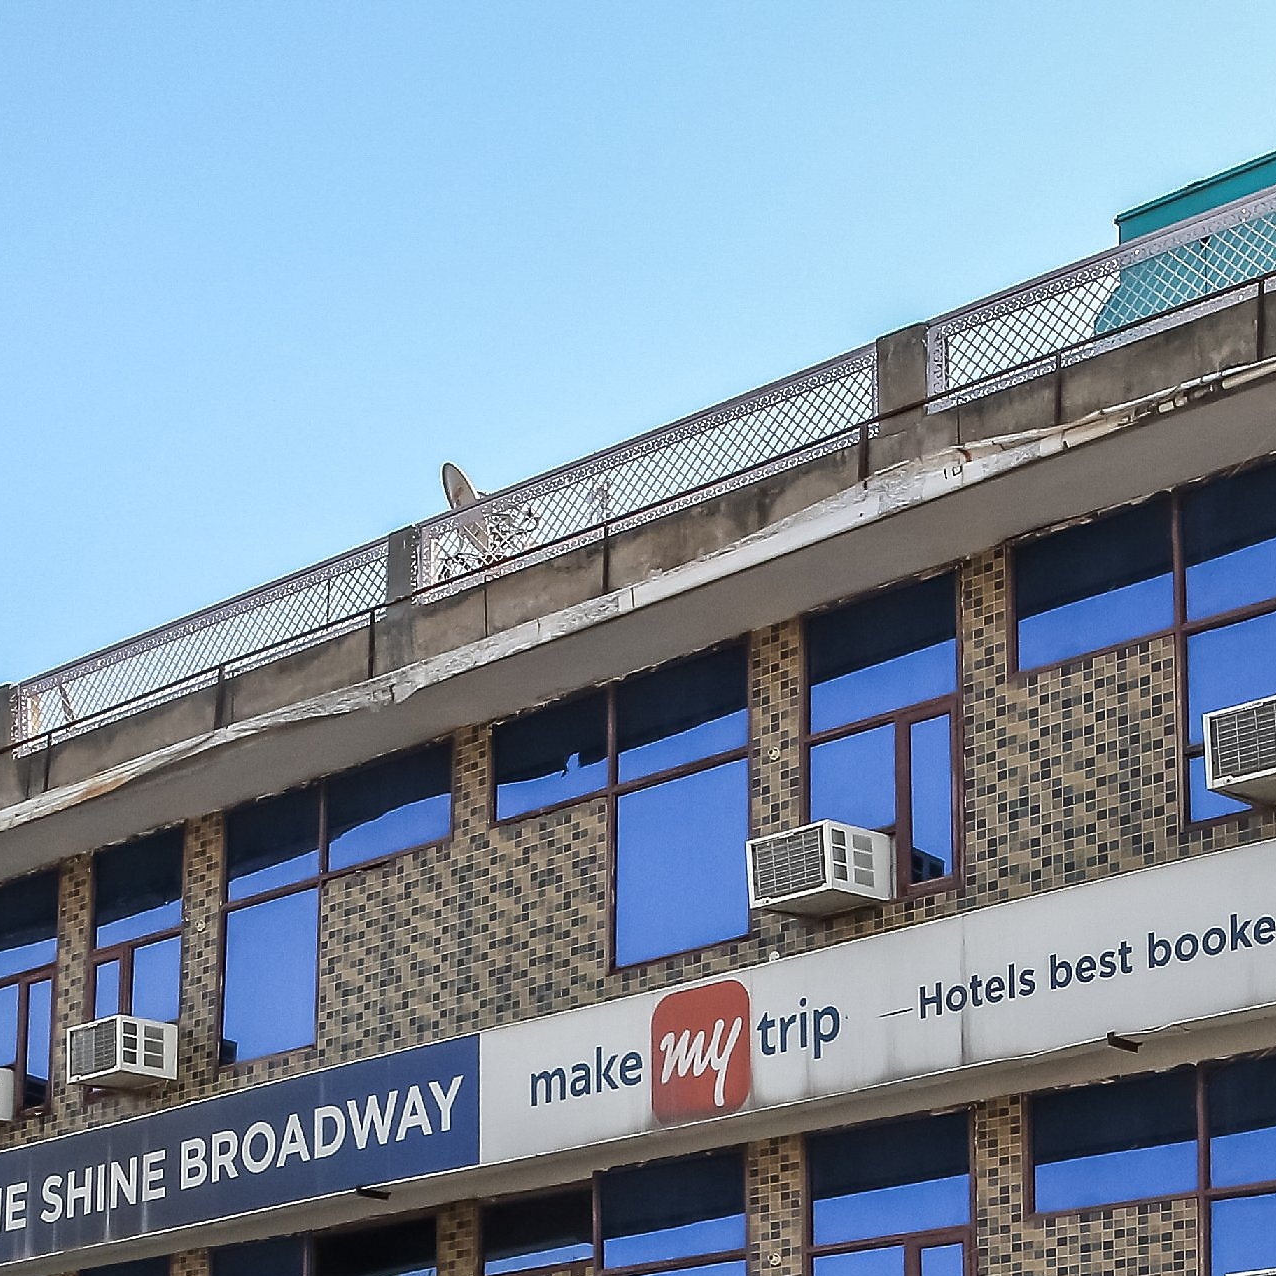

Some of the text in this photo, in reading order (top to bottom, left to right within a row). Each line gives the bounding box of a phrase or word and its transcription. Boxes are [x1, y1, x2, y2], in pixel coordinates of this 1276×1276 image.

[918, 961, 1036, 1021] Hotels
[1048, 944, 1134, 991] best
[530, 997, 841, 1108] make my trip
[40, 1150, 167, 1224] SHINE
[179, 1075, 466, 1191] BROADWAY
